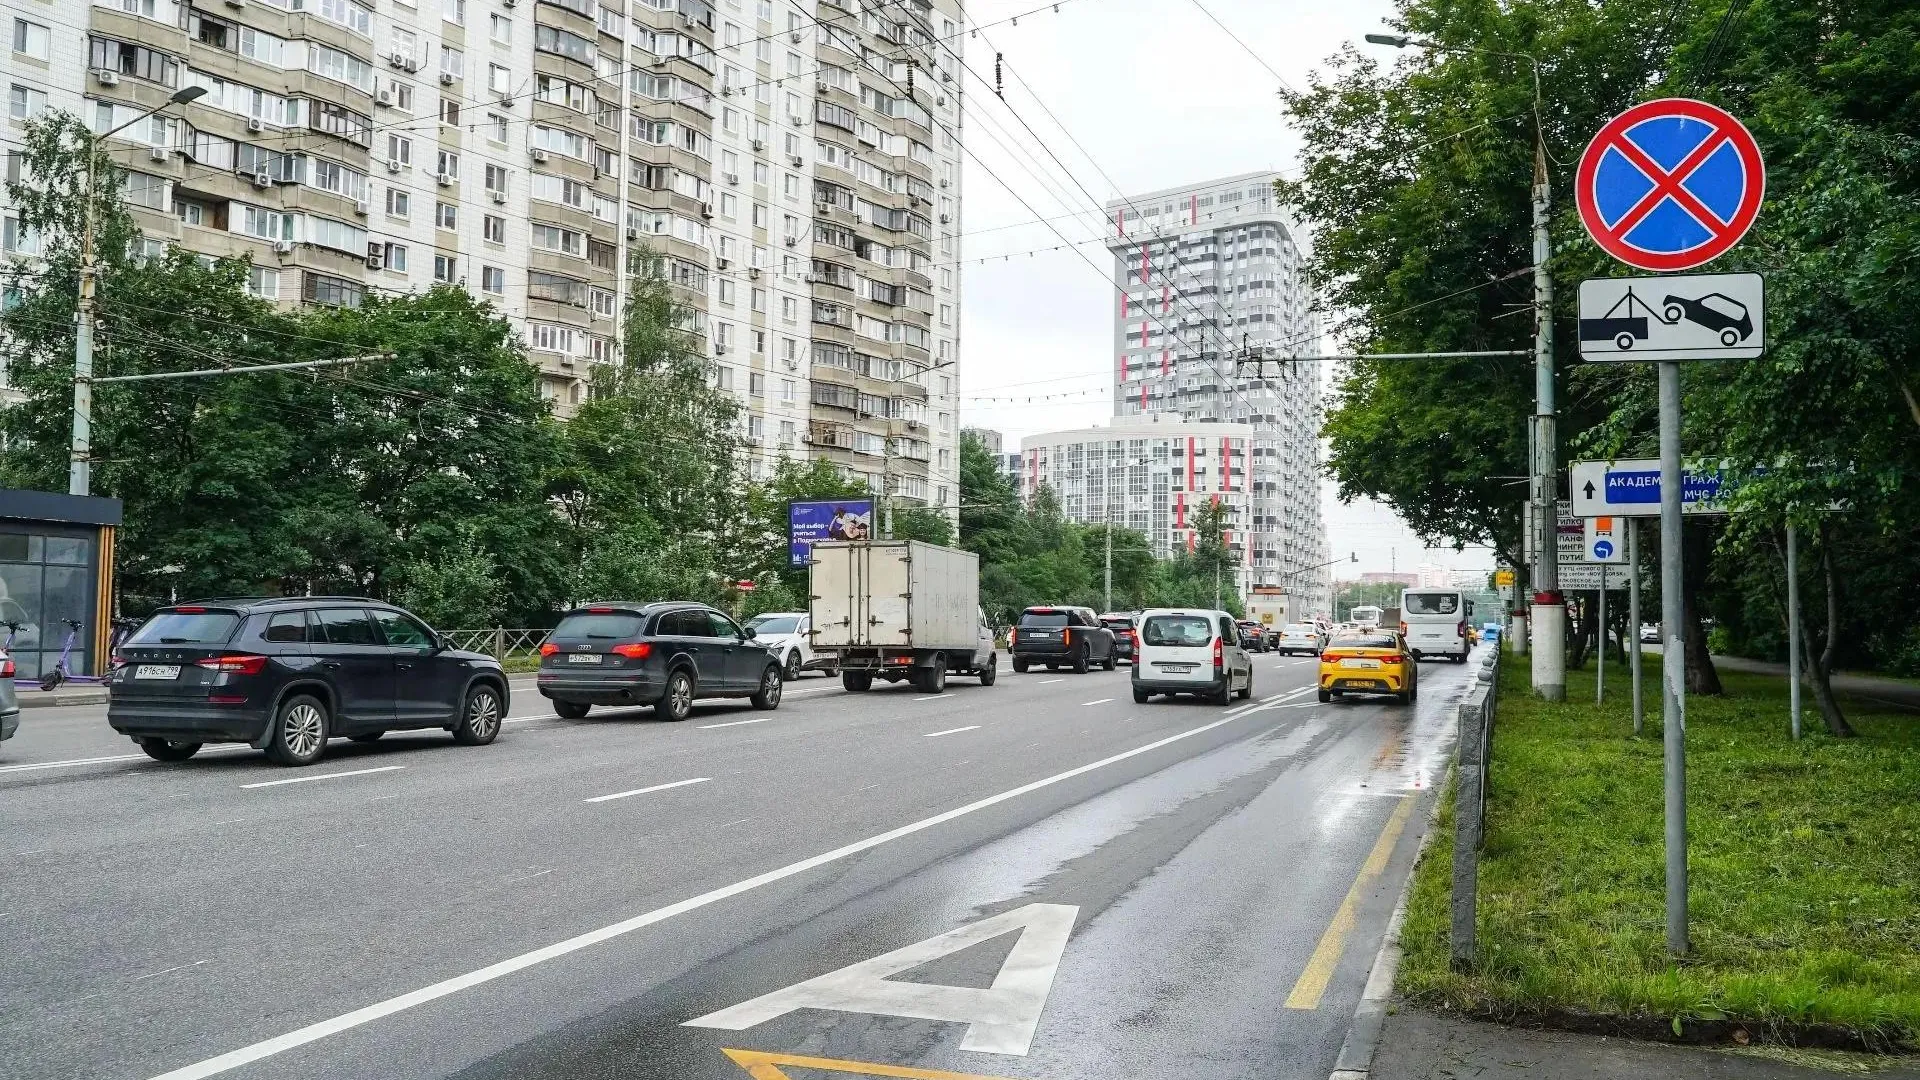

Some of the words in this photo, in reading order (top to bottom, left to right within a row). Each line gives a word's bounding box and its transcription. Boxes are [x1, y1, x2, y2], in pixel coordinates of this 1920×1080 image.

[1609, 476, 1661, 488] АКАДЕМ
[1683, 474, 1721, 485] ГРАЖ
[1684, 489, 1710, 500] МЧС
[1715, 489, 1732, 499] РО
